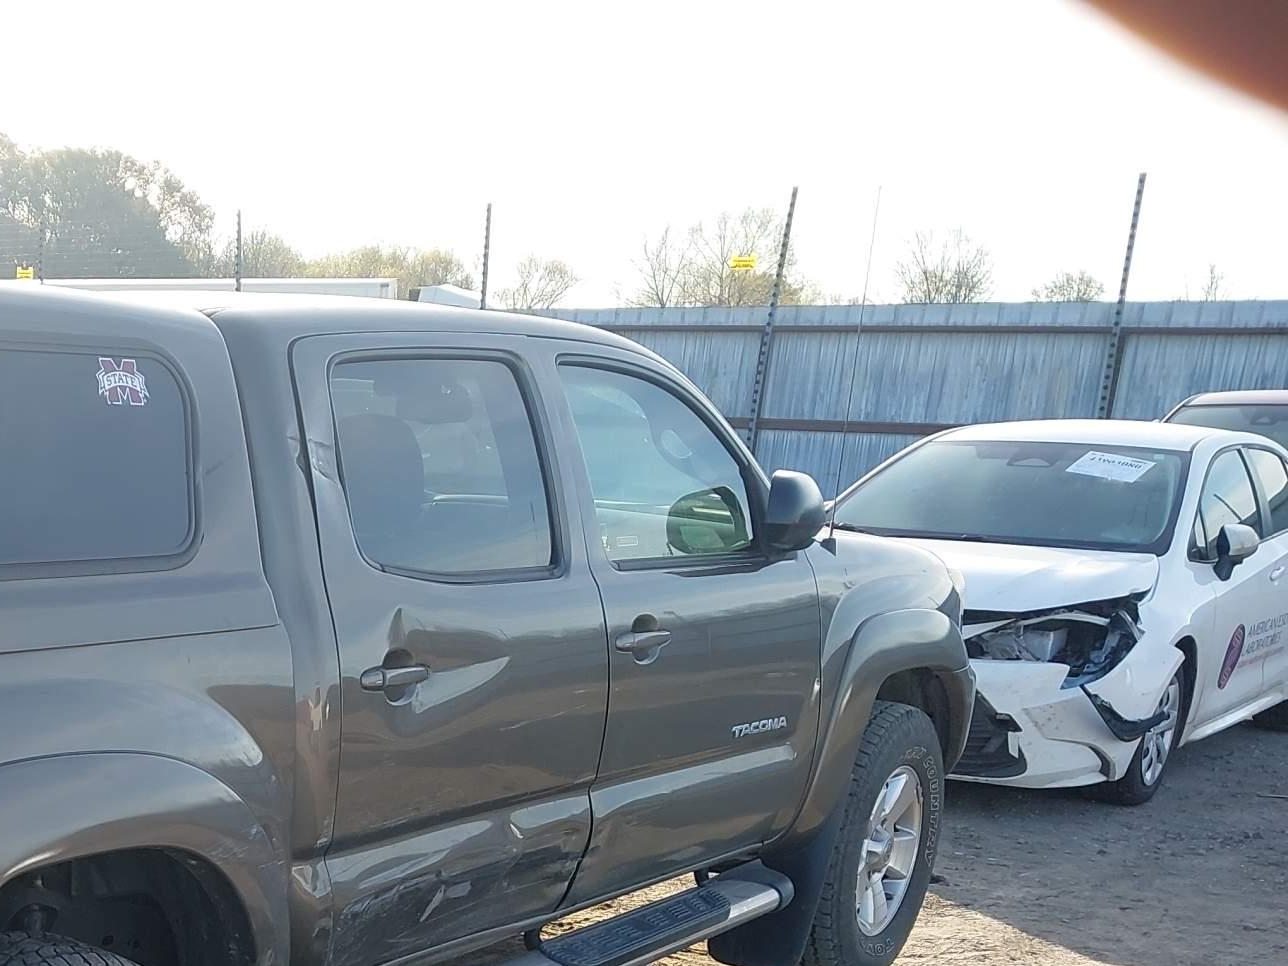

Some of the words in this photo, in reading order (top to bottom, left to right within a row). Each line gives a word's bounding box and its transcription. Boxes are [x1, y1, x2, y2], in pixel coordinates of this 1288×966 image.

[103, 371, 140, 390] STATE
[731, 715, 788, 738] TACOMA
[922, 755, 940, 868] COUNTRY
